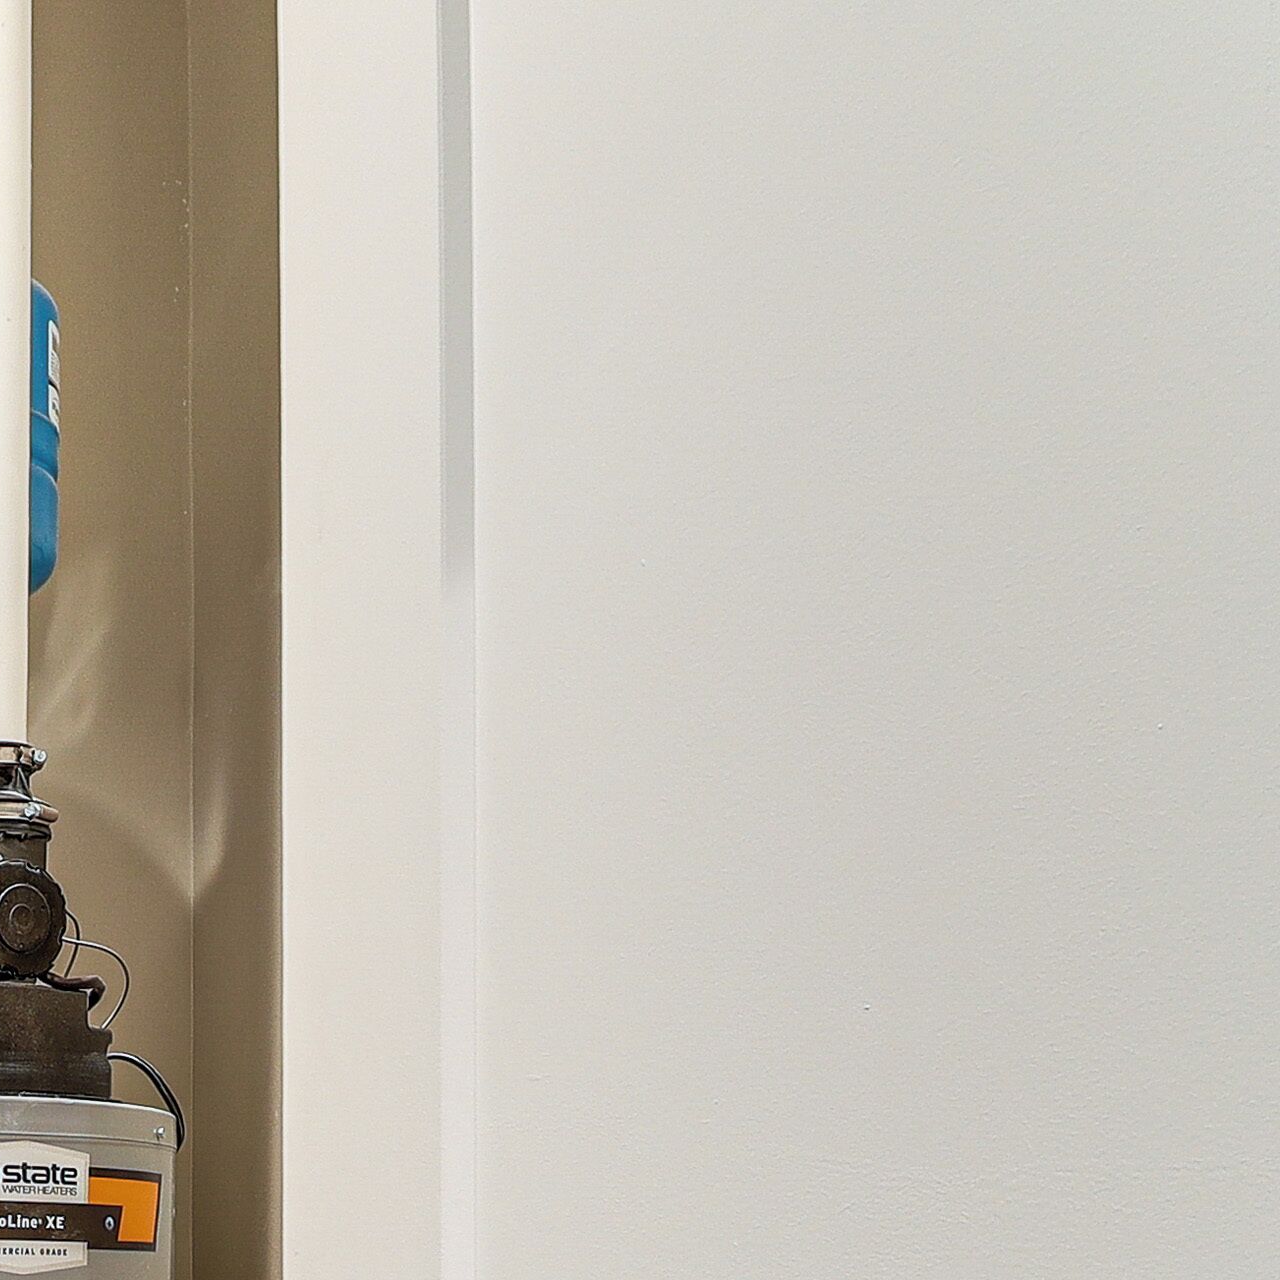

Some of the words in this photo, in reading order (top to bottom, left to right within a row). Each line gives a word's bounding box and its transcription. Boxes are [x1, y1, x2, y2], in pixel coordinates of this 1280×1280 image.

[2, 1162, 77, 1185] state
[2, 1185, 37, 1193] WATER
[38, 1185, 77, 1196] HEATERS
[46, 1215, 65, 1229] XE
[40, 1248, 68, 1256] GRADE
